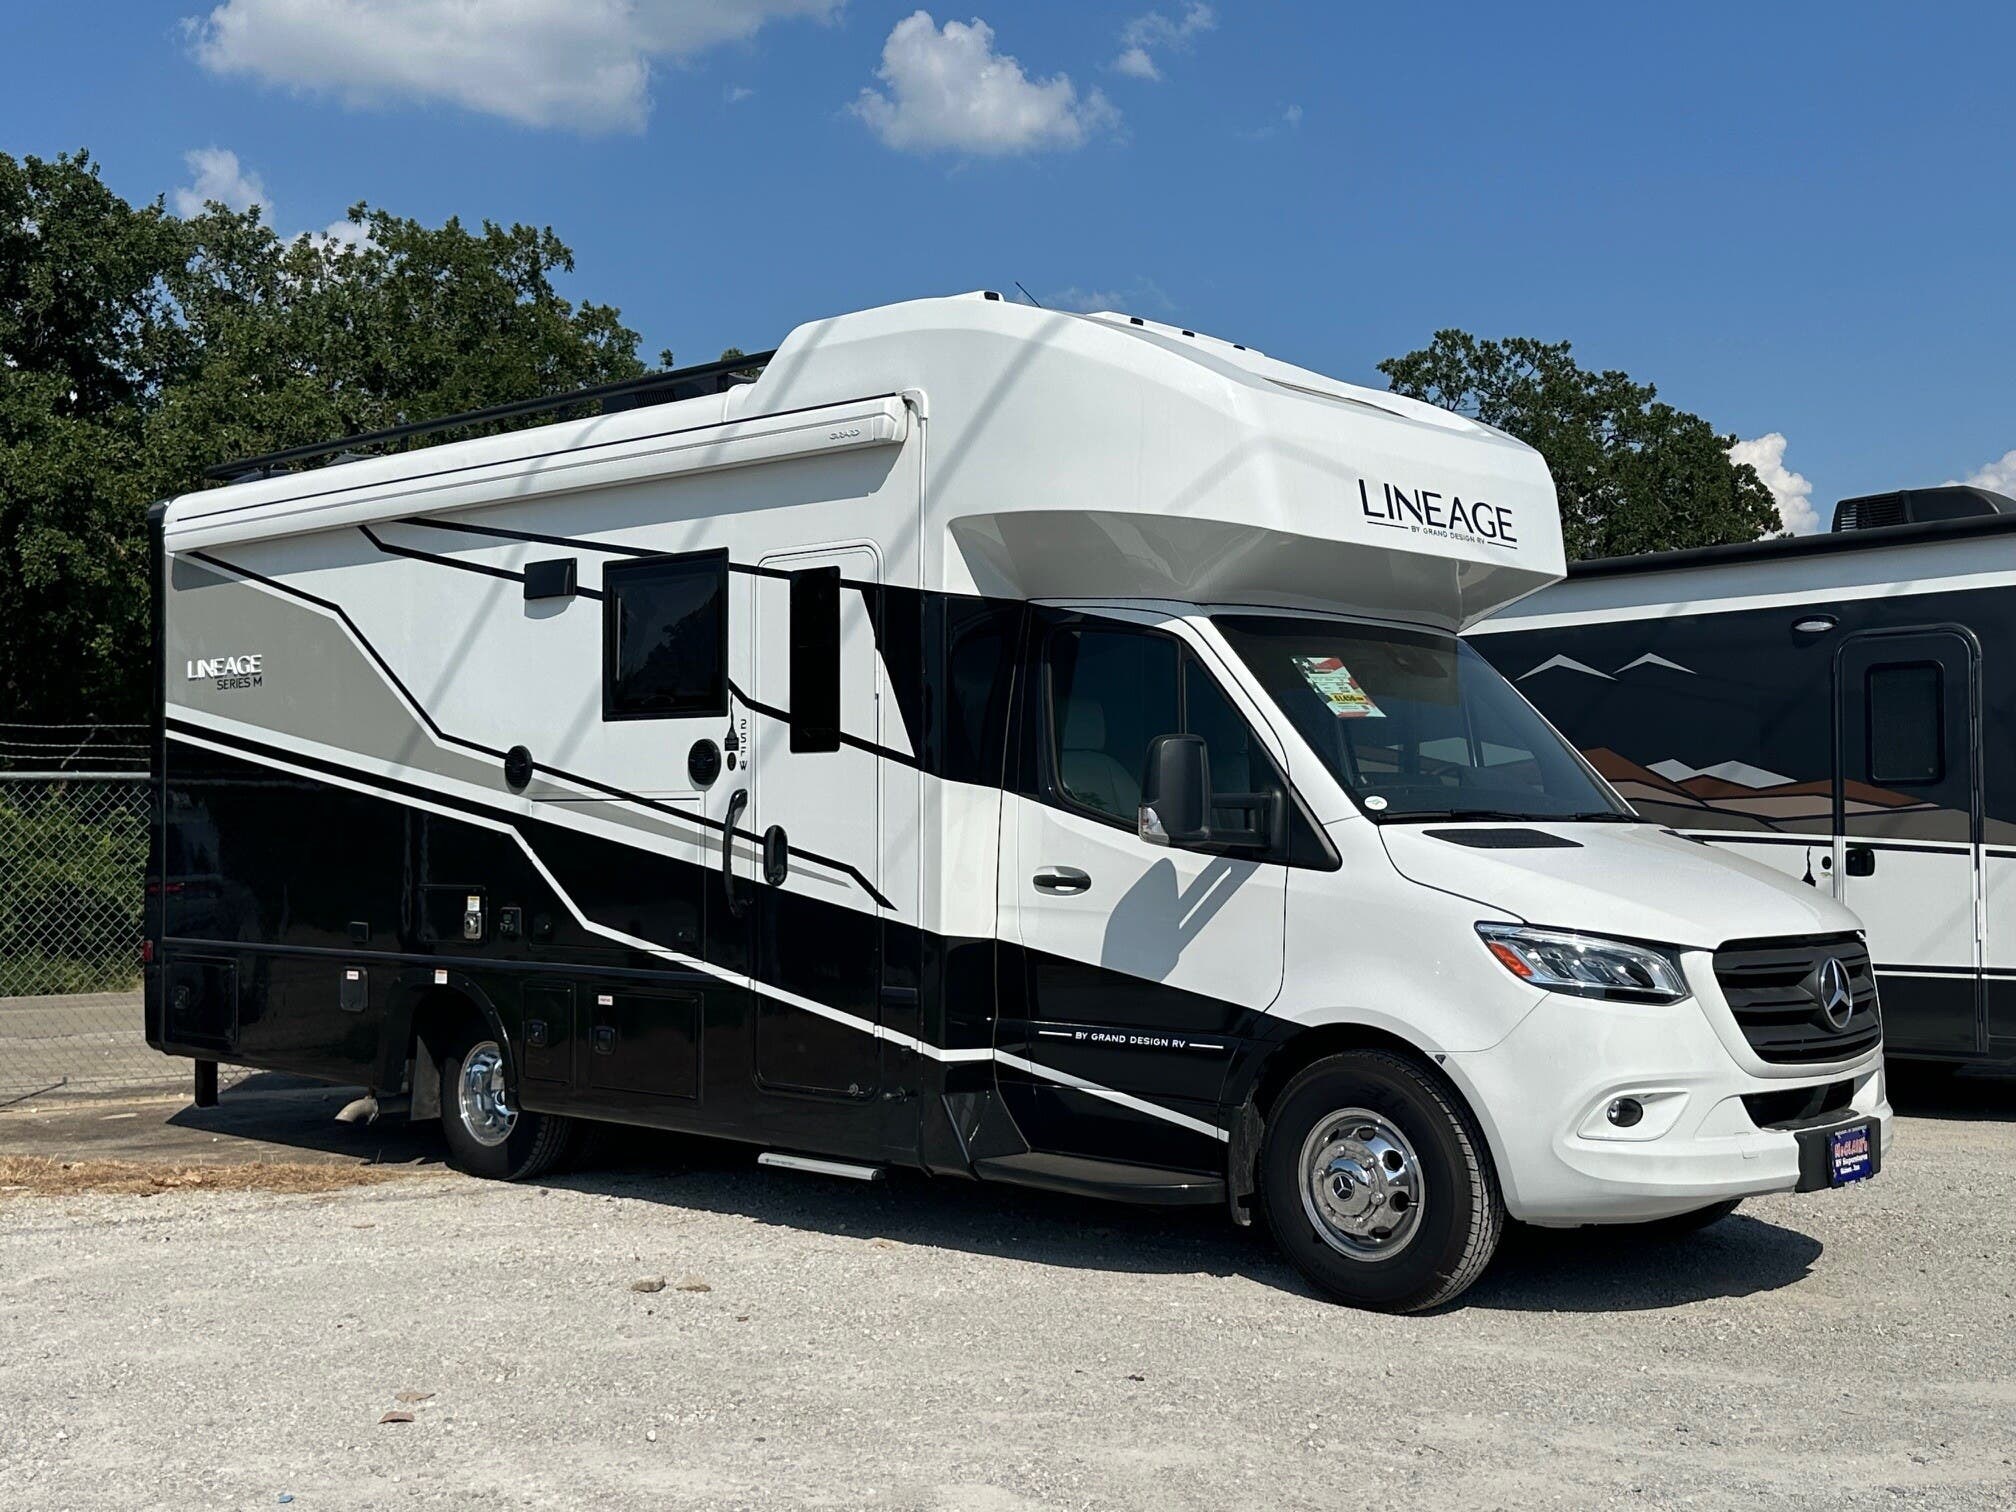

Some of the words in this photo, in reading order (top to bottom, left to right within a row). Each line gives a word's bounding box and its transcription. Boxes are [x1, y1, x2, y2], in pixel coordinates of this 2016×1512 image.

[1358, 479, 1518, 542] LINEAGE
[1411, 525, 1420, 533] BY
[1423, 527, 1448, 538] GRAND
[1450, 532, 1475, 543] DESIGN
[187, 654, 262, 680] LINEAGE
[217, 677, 251, 691] SERIES
[253, 676, 263, 688] M
[1075, 1031, 1088, 1040] BY
[1091, 1033, 1126, 1043] GRAND
[1130, 1036, 1168, 1047] DESIGN
[1172, 1039, 1186, 1048] RV
